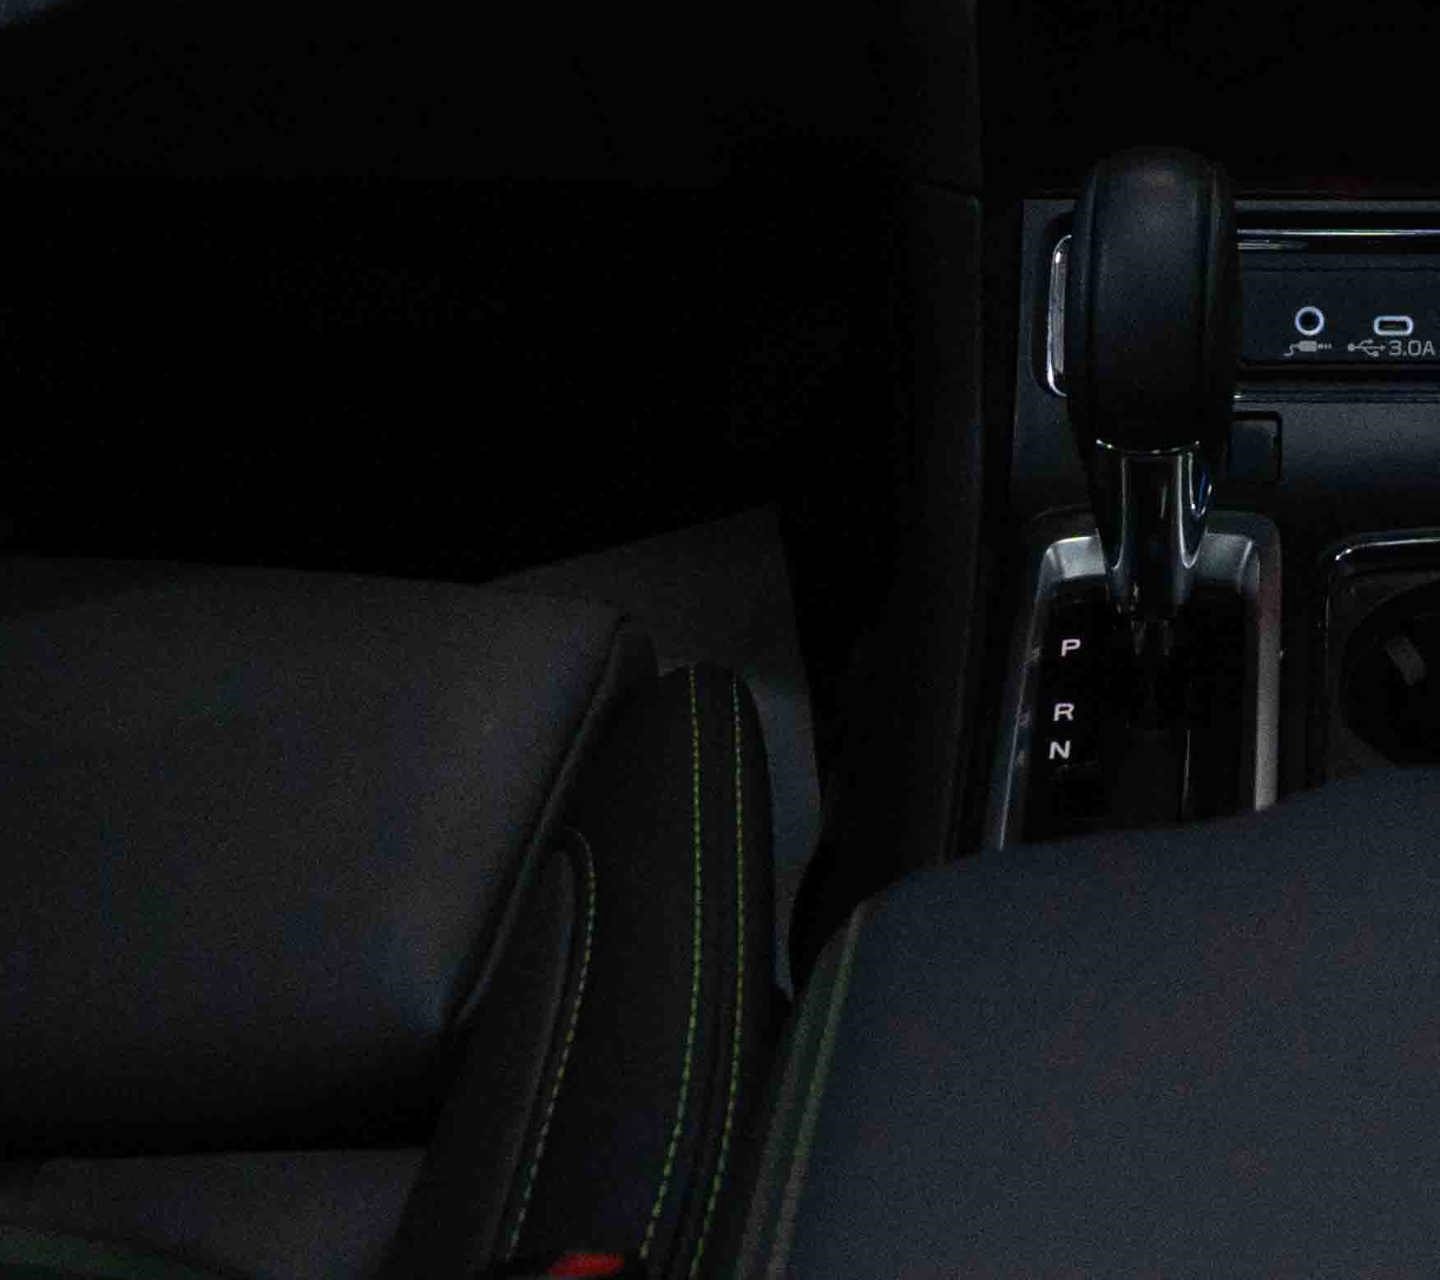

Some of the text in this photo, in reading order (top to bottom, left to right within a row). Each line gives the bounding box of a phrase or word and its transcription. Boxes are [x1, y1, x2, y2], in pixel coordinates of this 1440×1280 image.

[1388, 339, 1436, 357] 3.0A
[1061, 638, 1081, 657] P
[1053, 702, 1075, 722] R
[1049, 740, 1071, 760] N
